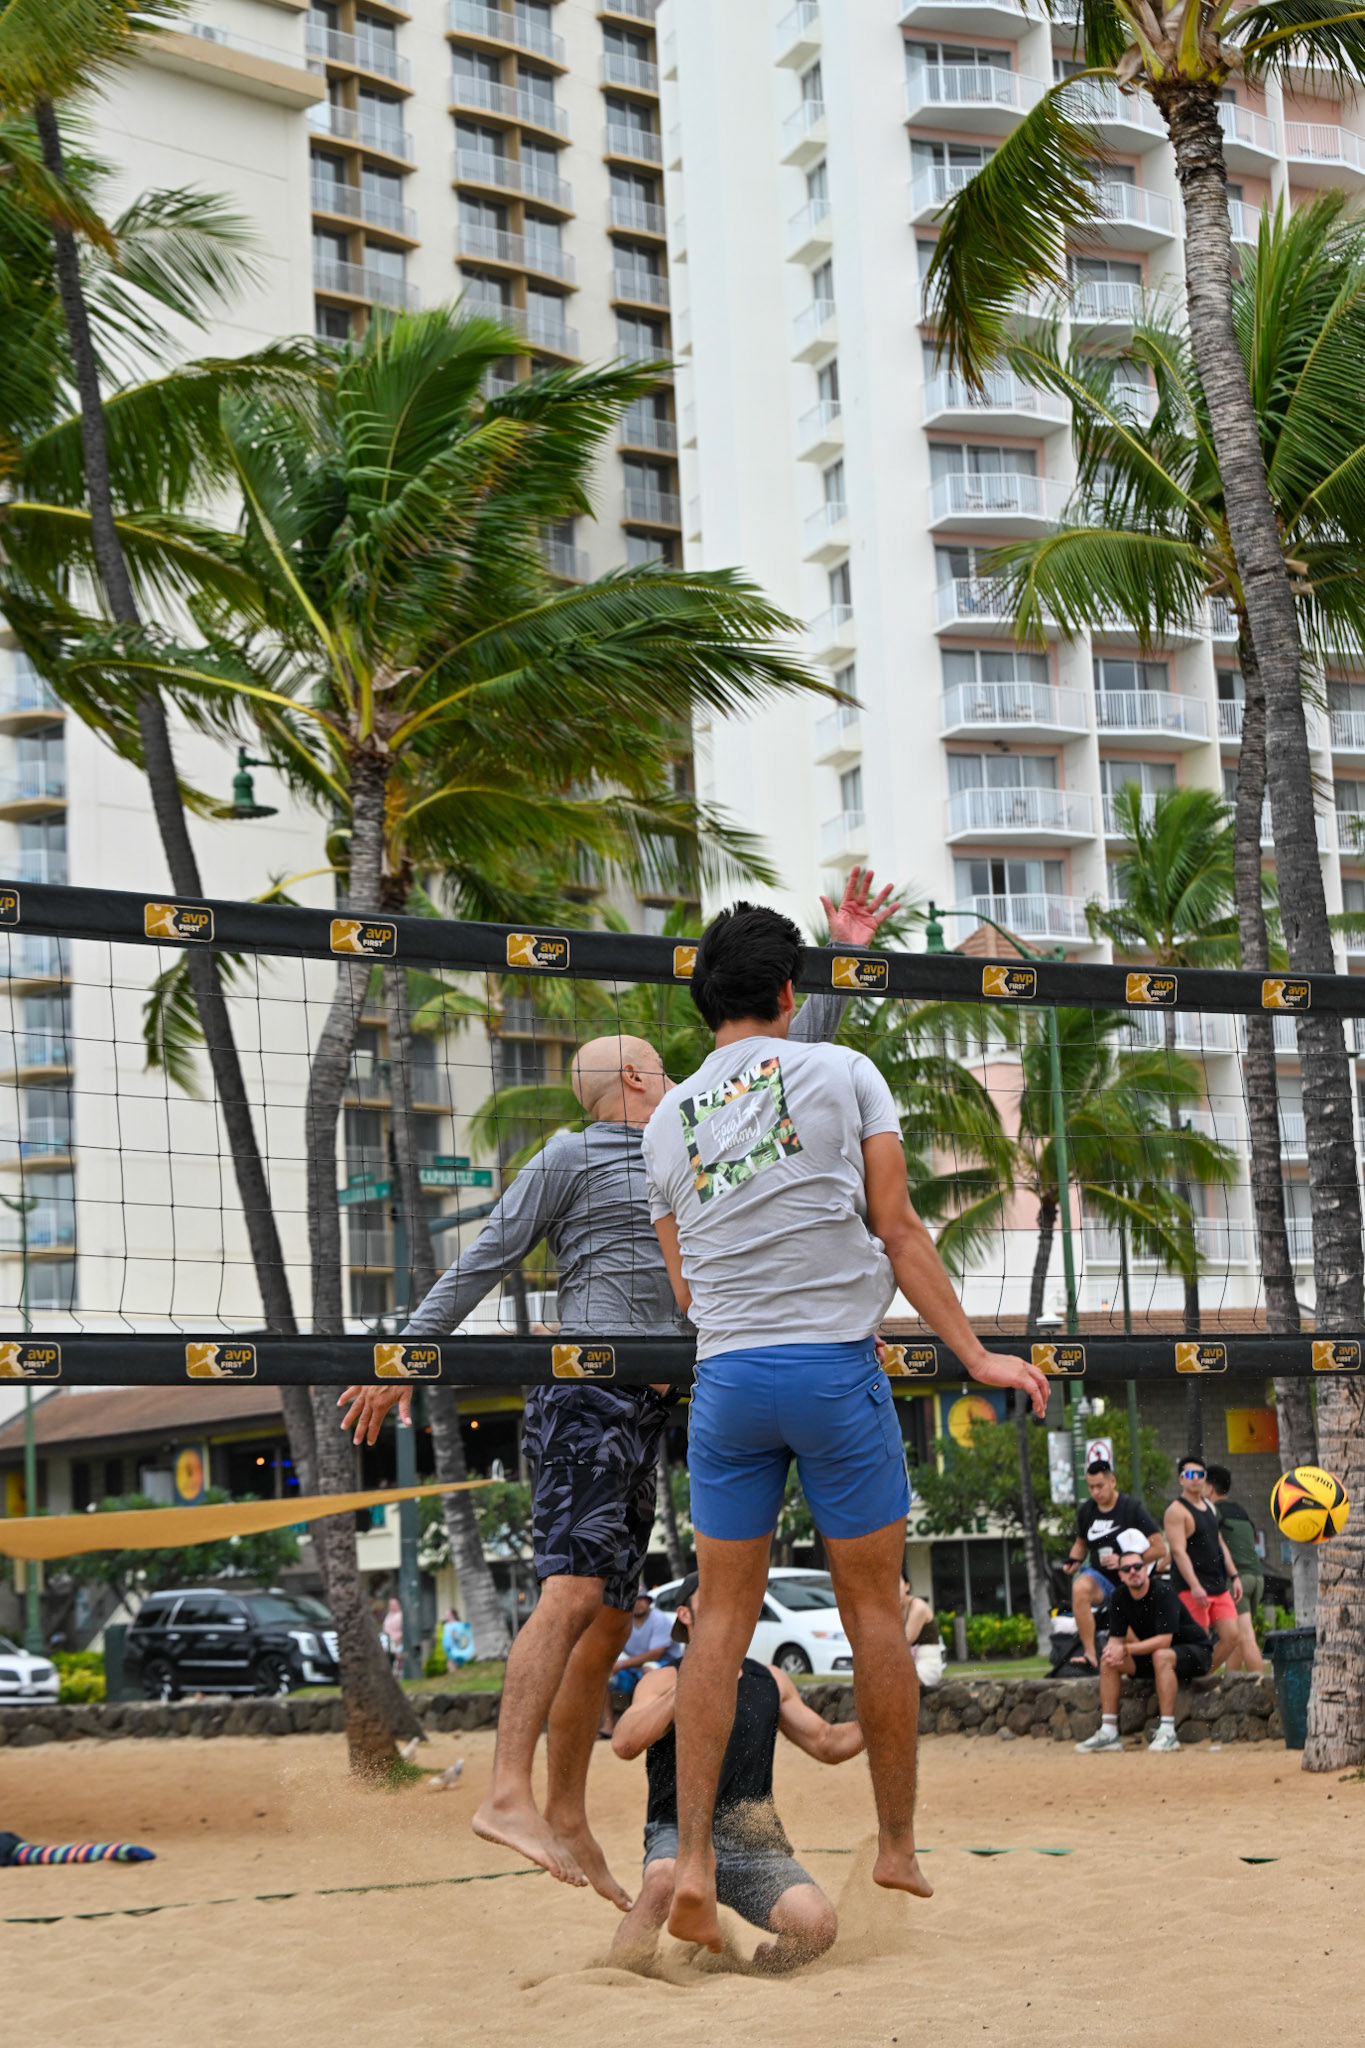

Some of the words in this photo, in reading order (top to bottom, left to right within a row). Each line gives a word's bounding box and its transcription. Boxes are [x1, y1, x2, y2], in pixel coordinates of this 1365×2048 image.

[181, 912, 209, 927] avp
[178, 923, 200, 932] FIRST
[365, 928, 392, 943] avp
[362, 939, 384, 947] FIRST
[540, 942, 565, 957] avp
[863, 964, 886, 977] avp
[1012, 973, 1034, 986] avp
[1153, 980, 1174, 993] avp
[1287, 985, 1307, 998] avp
[710, 1106, 742, 1141] Local
[27, 1349, 56, 1363] avp
[225, 1349, 252, 1364] avp
[410, 1350, 437, 1364] avp
[586, 1351, 611, 1364] avp
[911, 1350, 933, 1363] avp
[1060, 1349, 1082, 1362] avp
[1203, 1347, 1224, 1360] avp
[1338, 1346, 1358, 1358] avp
[23, 1360, 46, 1368] FIRST
[583, 1361, 603, 1369] FIRST
